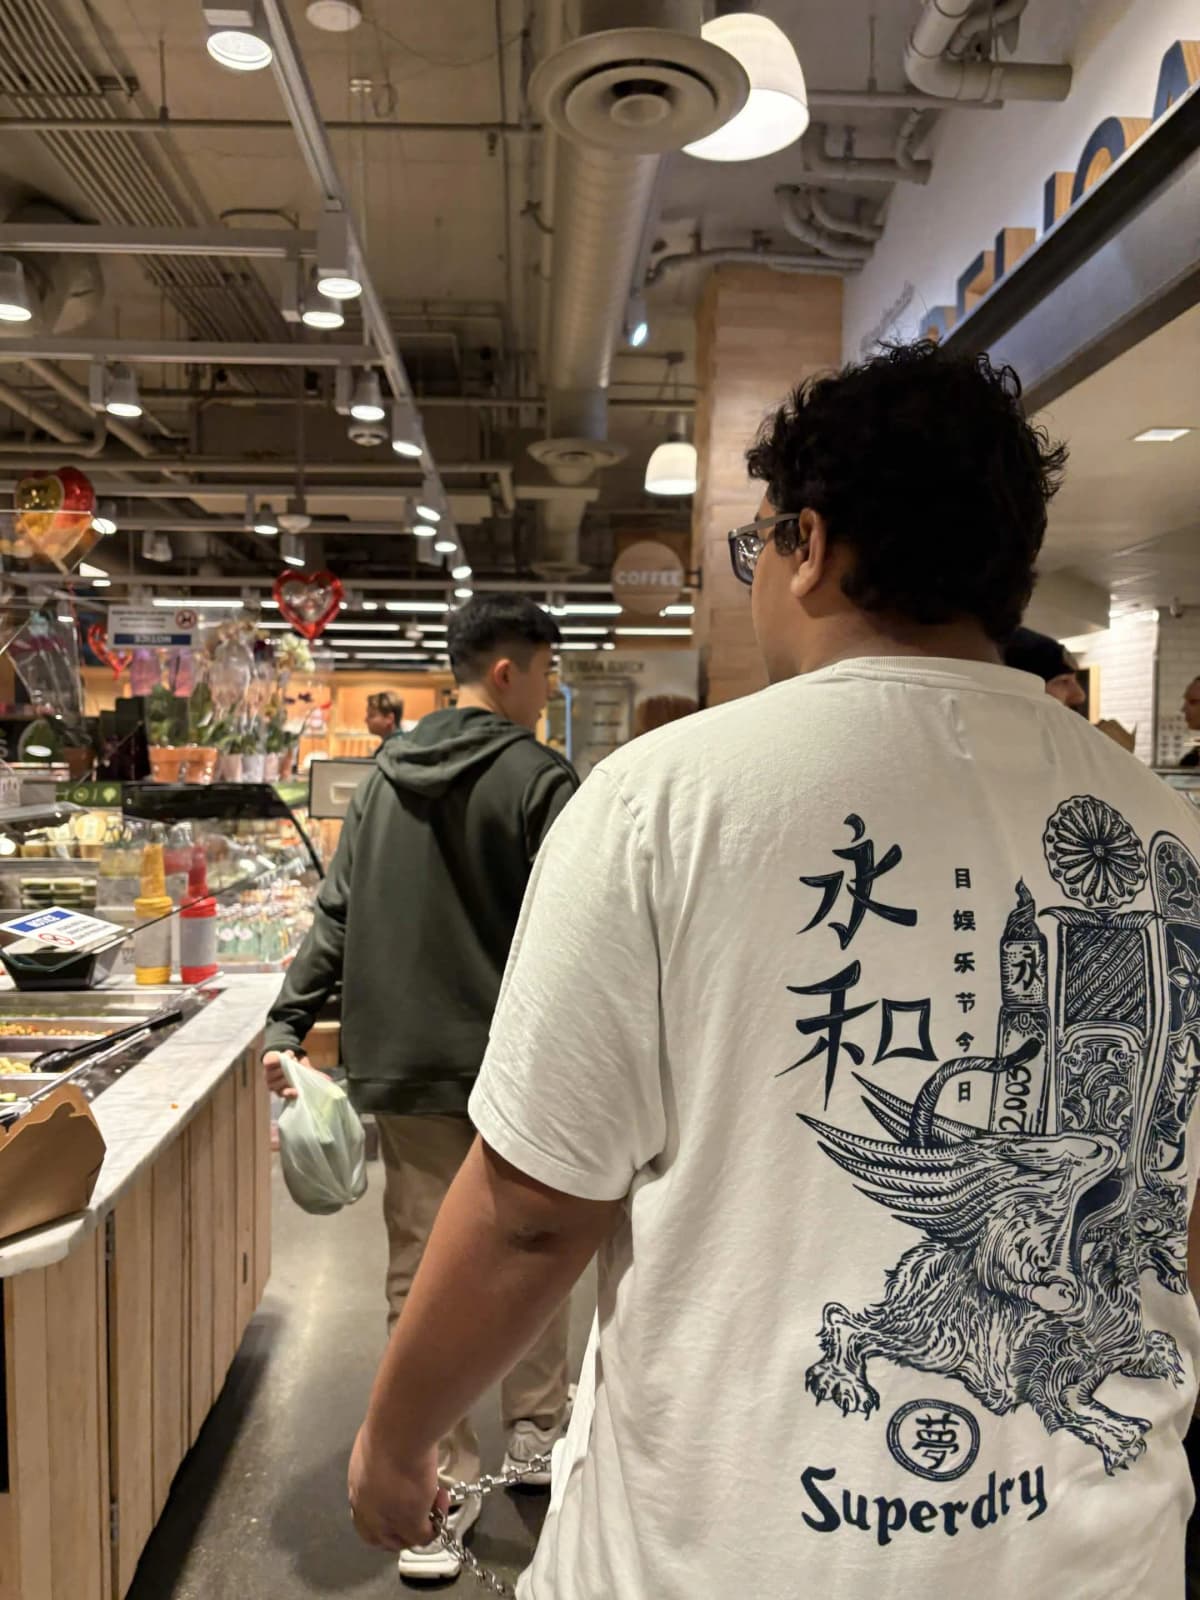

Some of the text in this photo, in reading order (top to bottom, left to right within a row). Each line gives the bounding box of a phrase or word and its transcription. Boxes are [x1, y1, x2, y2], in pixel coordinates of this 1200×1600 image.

[614, 570, 681, 586] COFFEE
[775, 813, 939, 1112] 永和
[999, 1064, 1032, 1133] 2003
[800, 1465, 1048, 1546] Superdry
